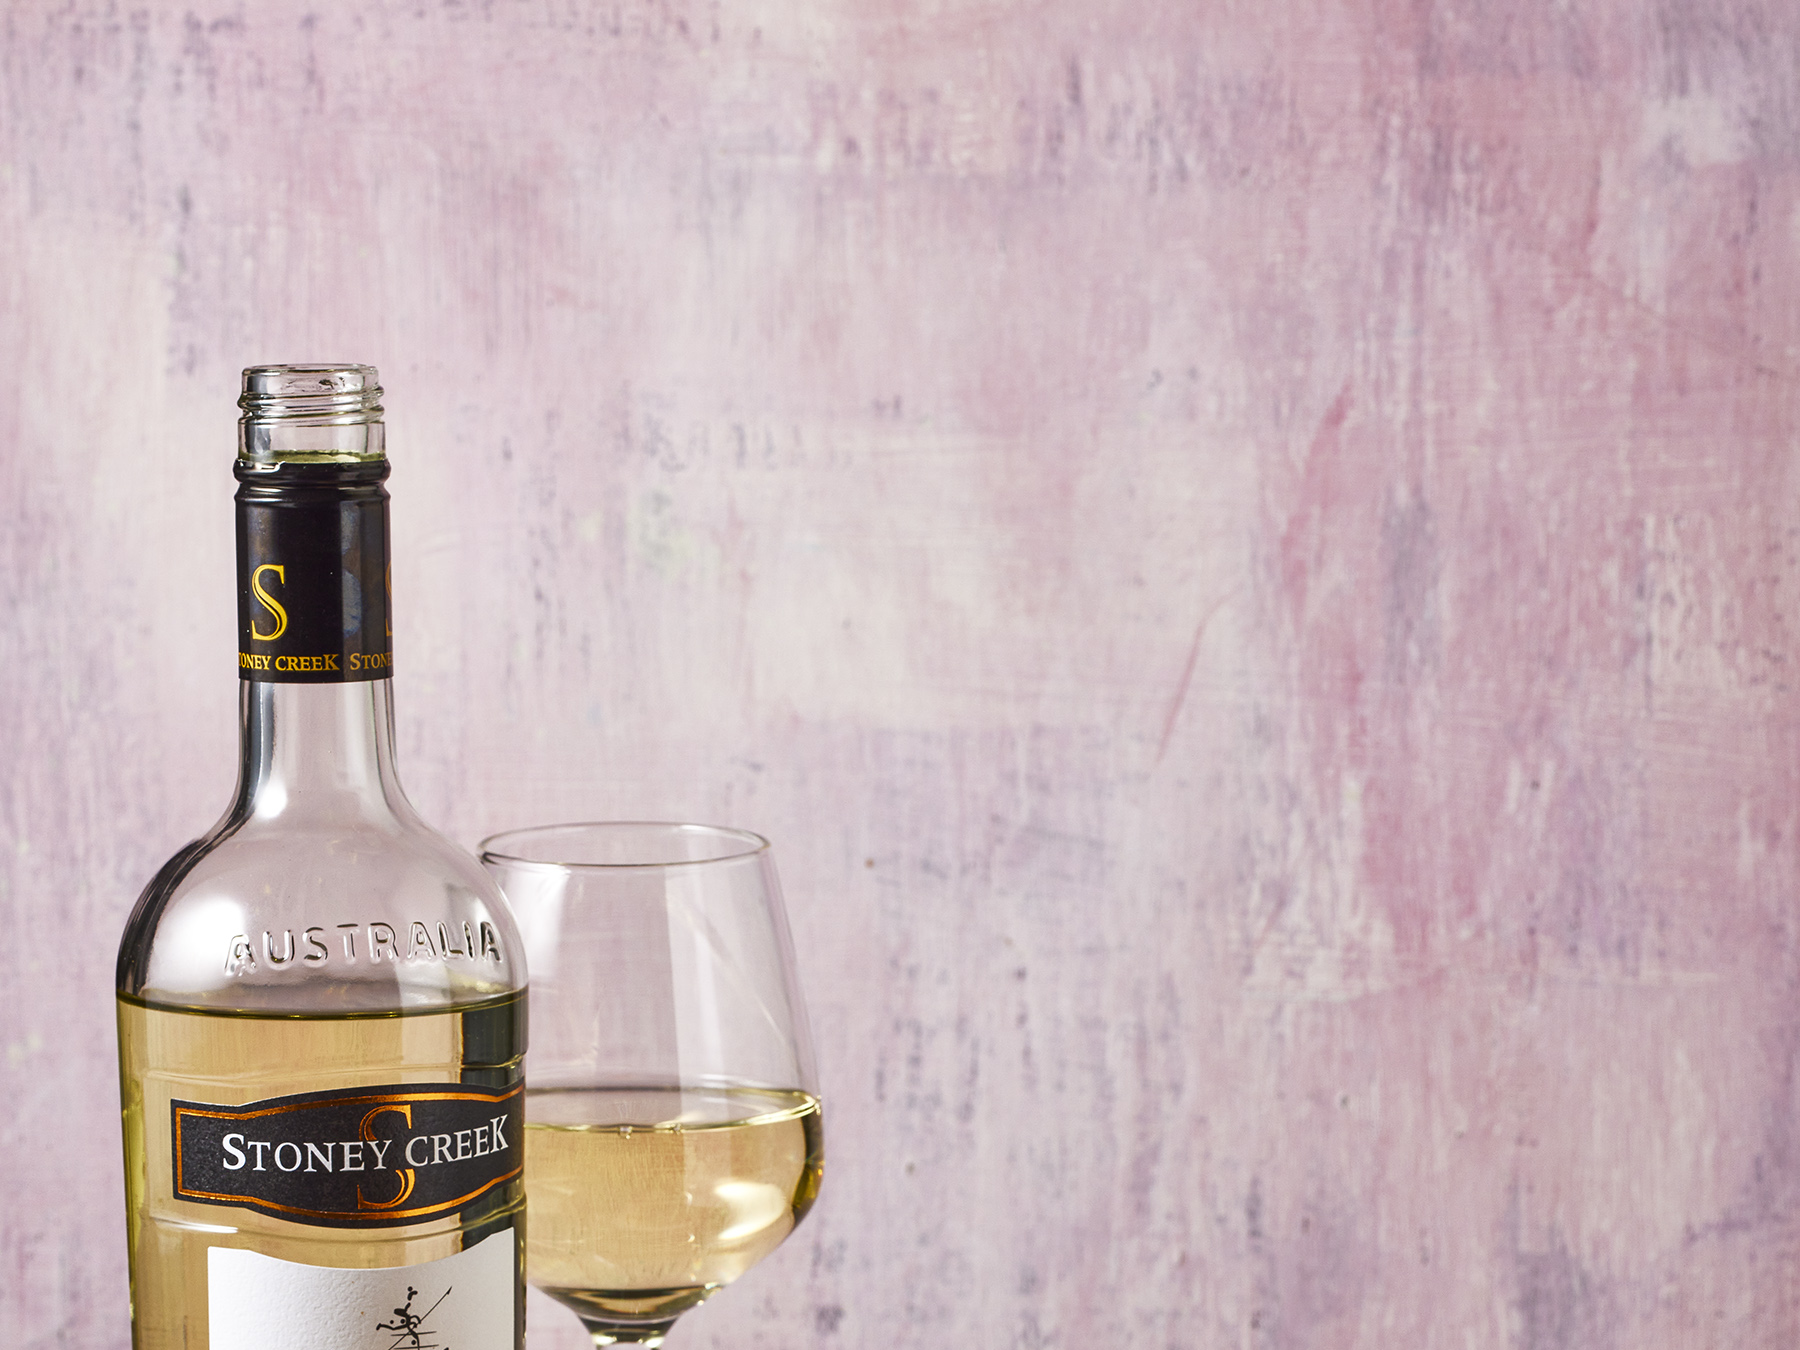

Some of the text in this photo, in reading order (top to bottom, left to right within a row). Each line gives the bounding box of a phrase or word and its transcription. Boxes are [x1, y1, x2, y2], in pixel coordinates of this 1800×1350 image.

[251, 564, 288, 641] S
[275, 654, 340, 671] CREEK
[224, 920, 503, 976] AUSTRALIA
[222, 1114, 509, 1173] STONEY CREEK
